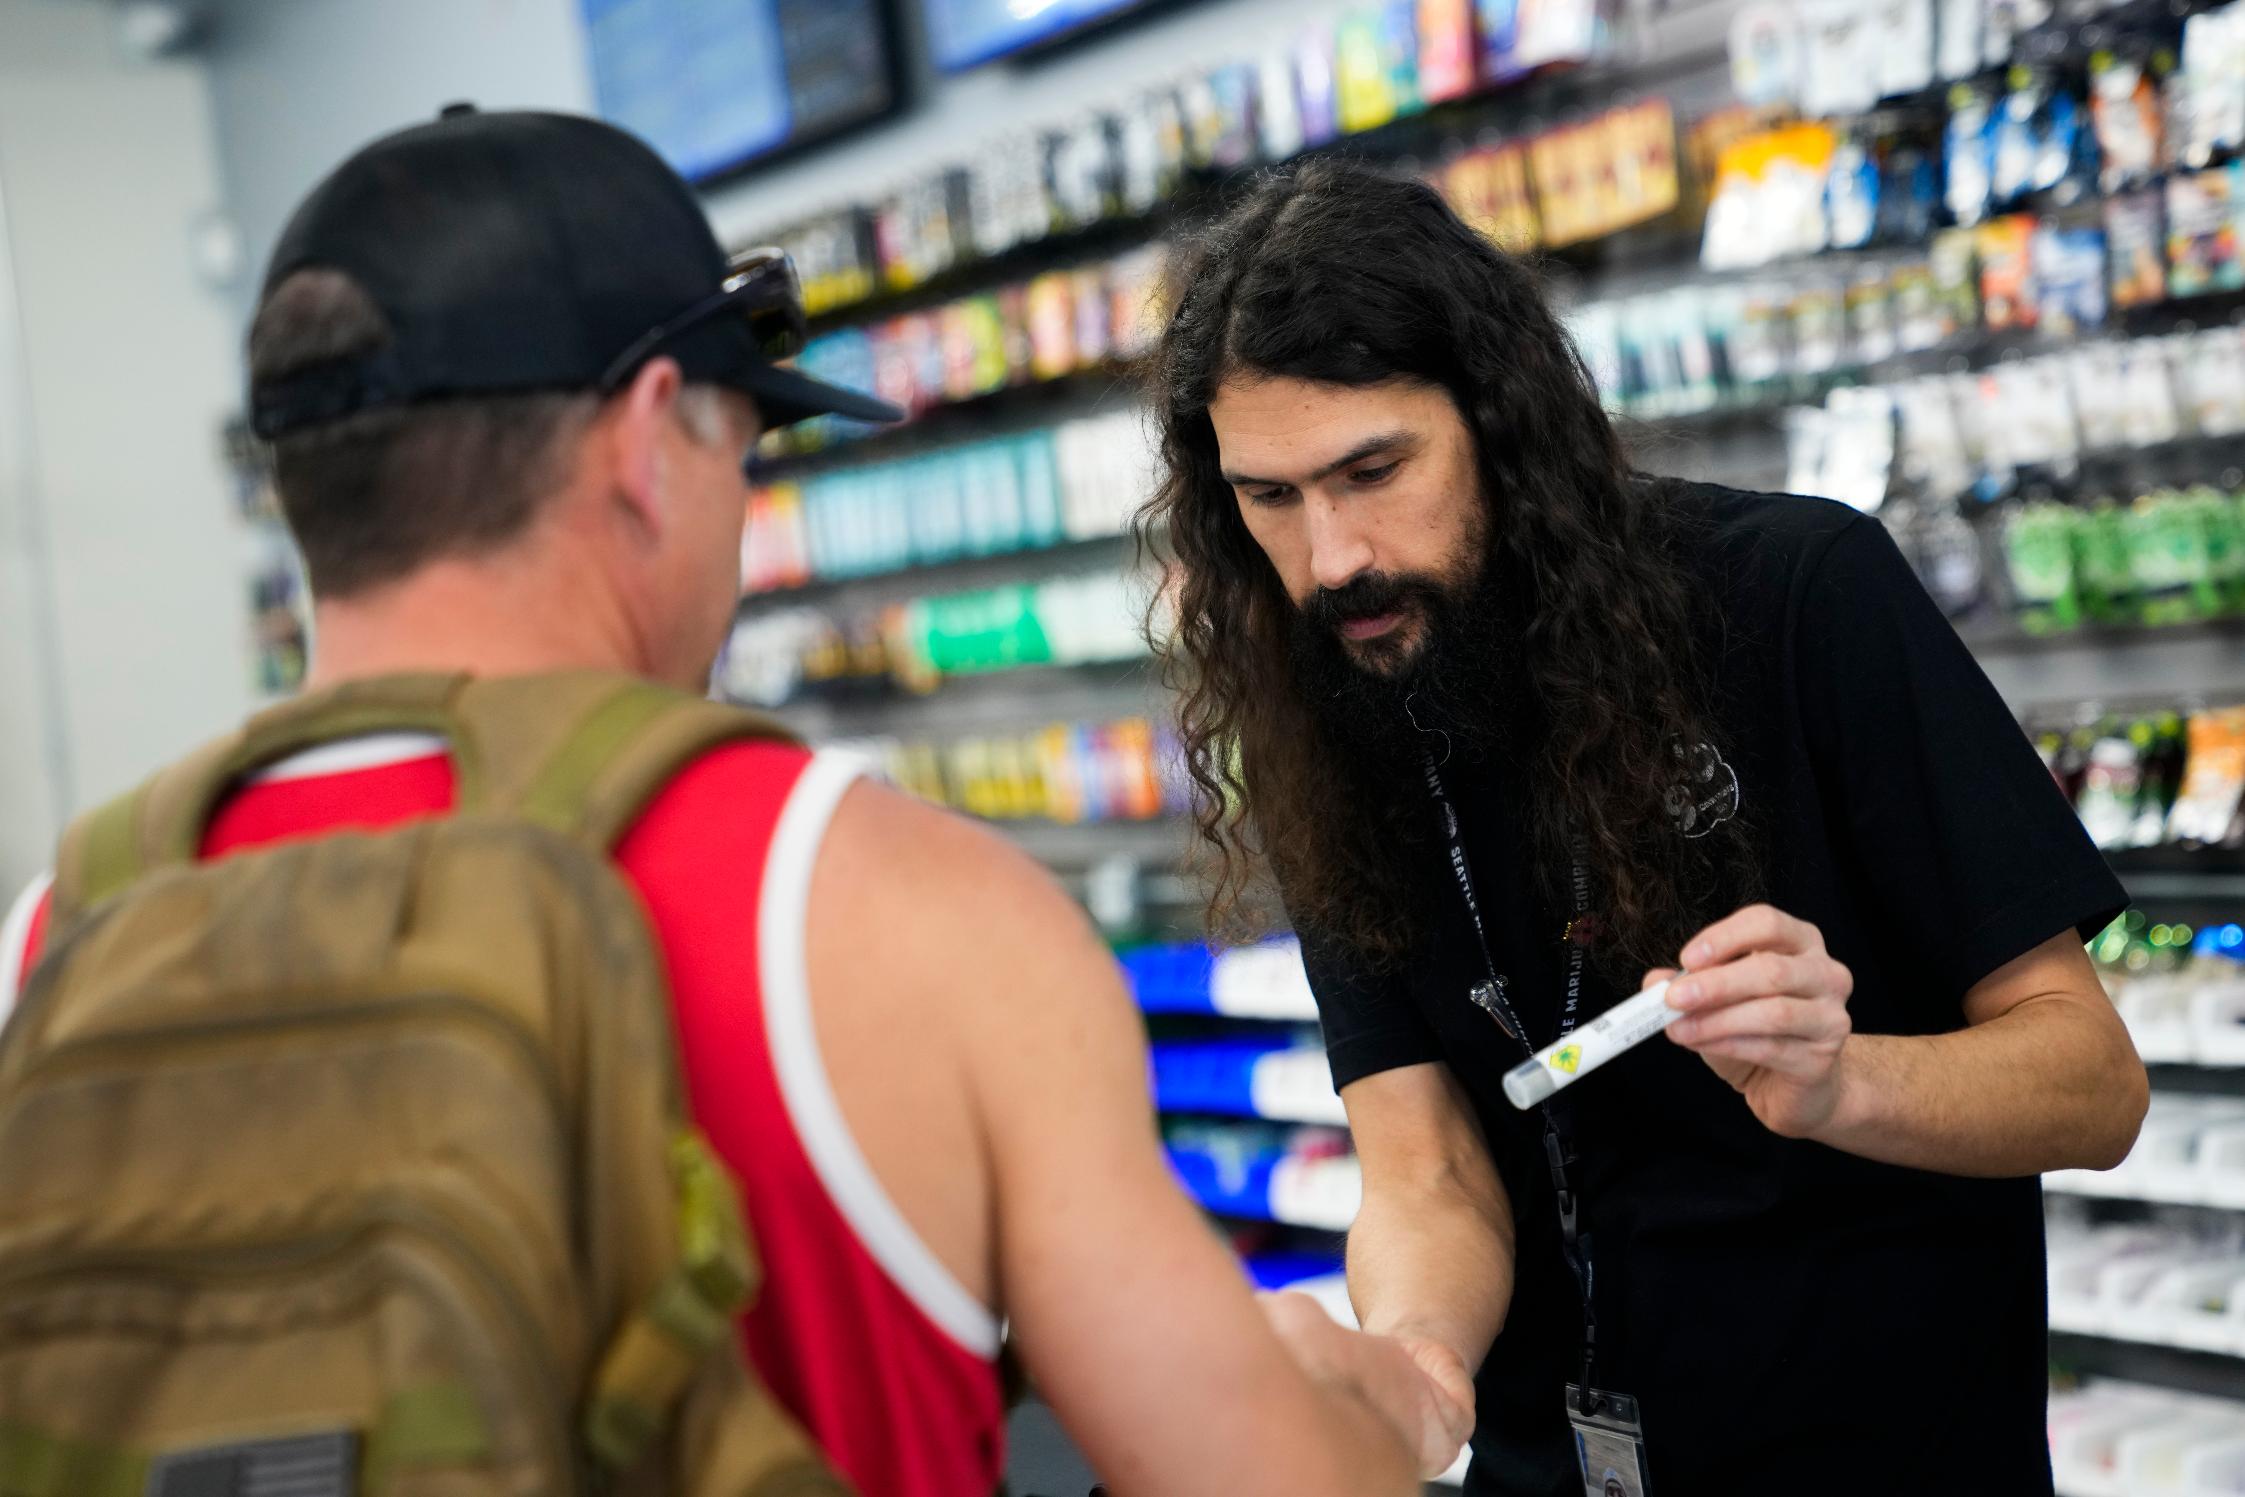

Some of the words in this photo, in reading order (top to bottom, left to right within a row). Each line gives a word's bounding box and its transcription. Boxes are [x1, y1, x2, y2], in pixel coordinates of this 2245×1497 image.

[1423, 751, 1444, 798] PANY
[1451, 846, 1476, 910] SEATTLE
[1565, 950, 1583, 1012] MARIJU
